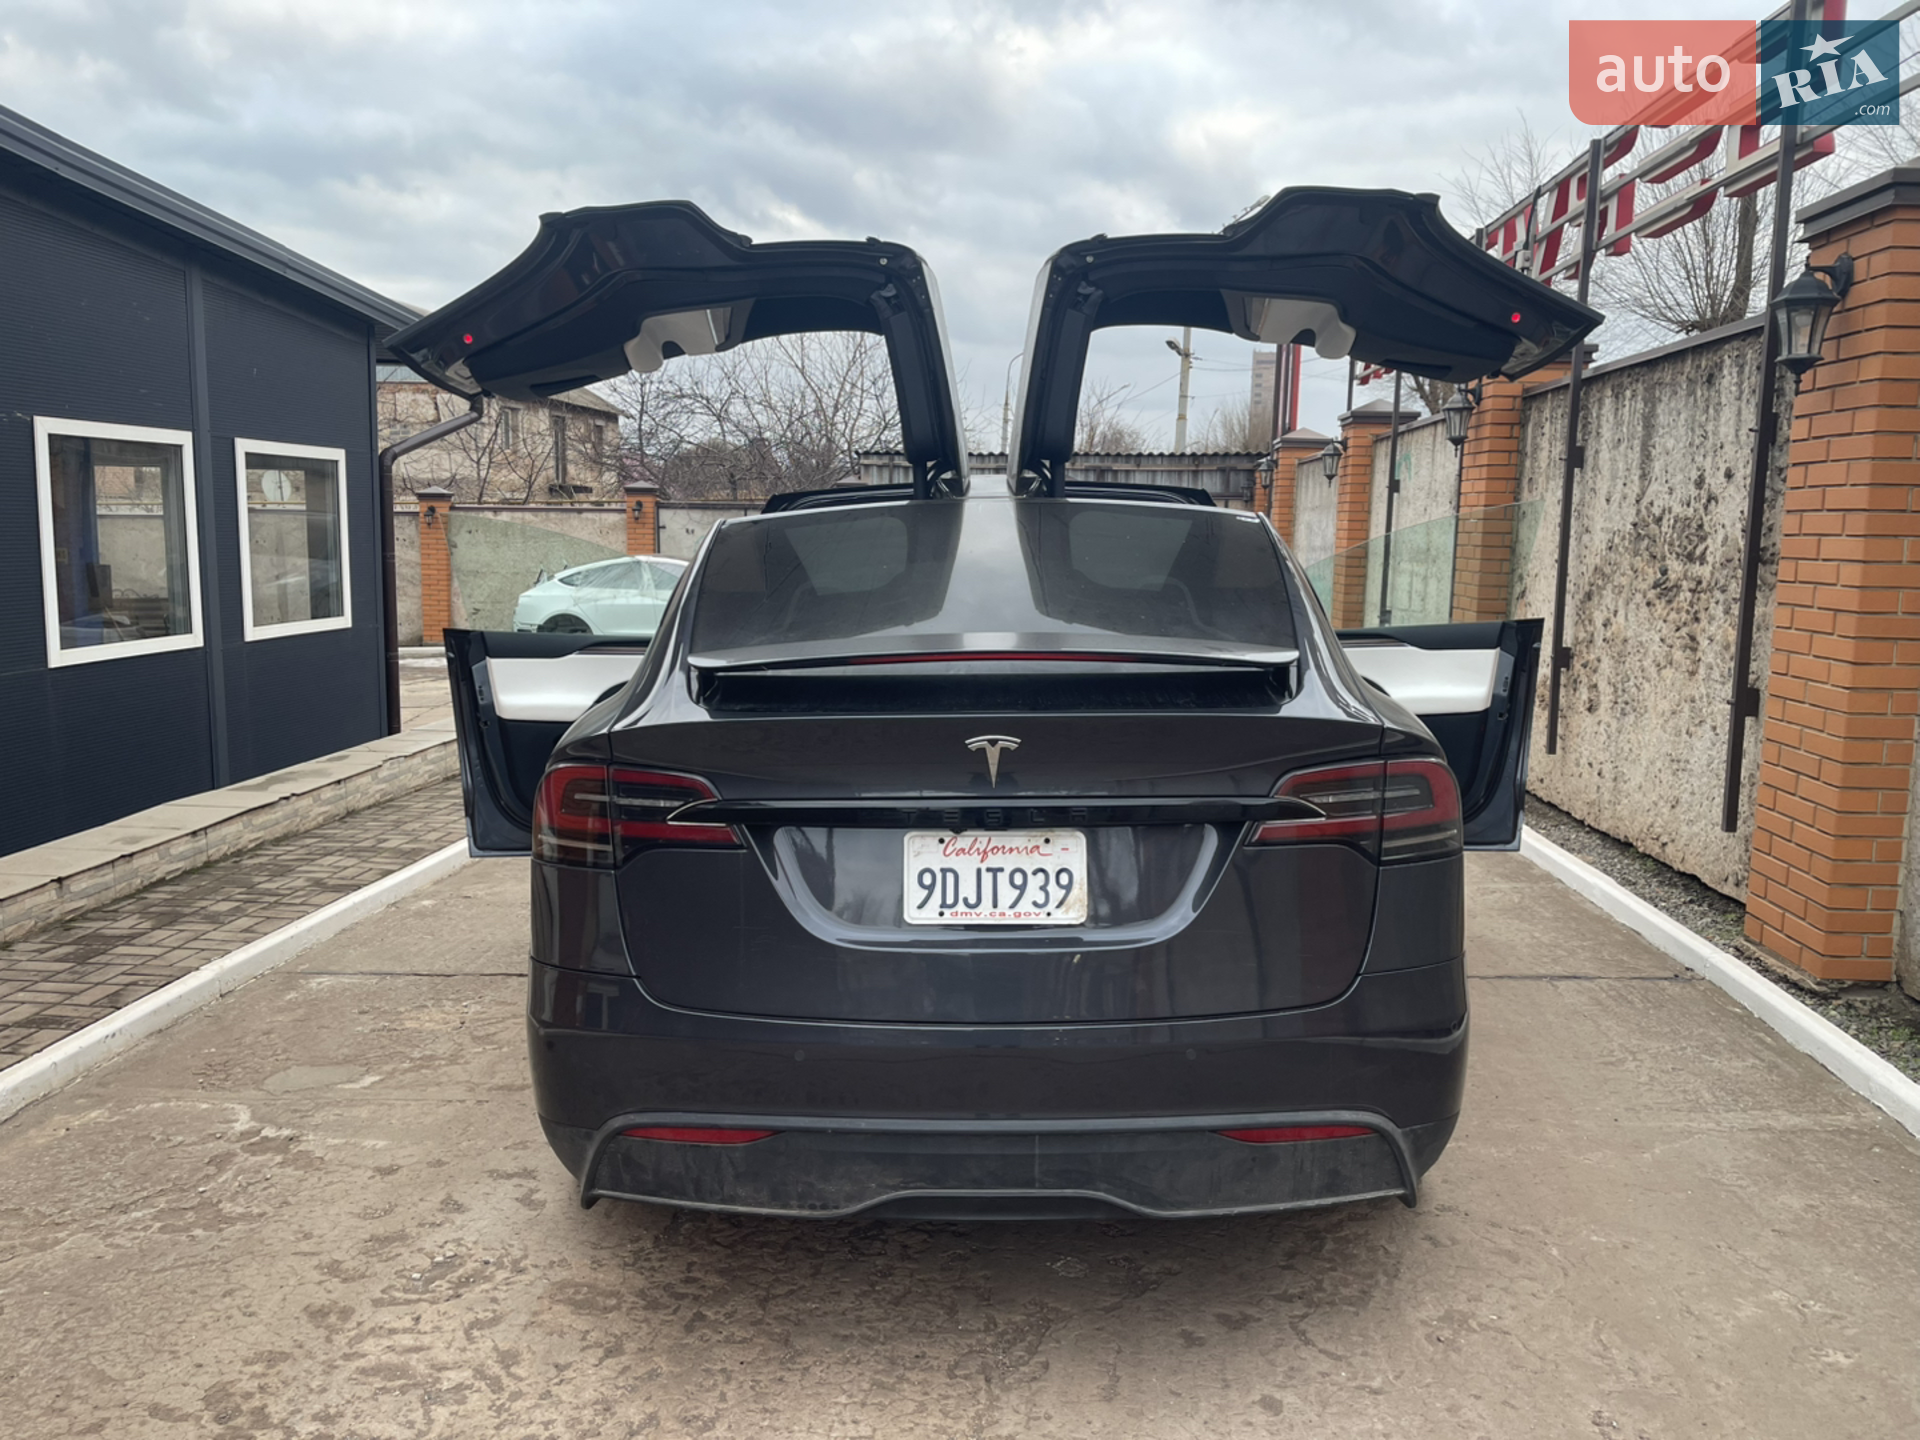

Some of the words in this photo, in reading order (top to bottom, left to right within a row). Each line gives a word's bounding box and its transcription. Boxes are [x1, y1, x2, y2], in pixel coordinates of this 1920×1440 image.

[901, 808, 1088, 824] TESLA
[942, 836, 1053, 863] California
[917, 867, 1074, 909] 9DJT939
[949, 909, 1042, 918] dmv.ca.gov
